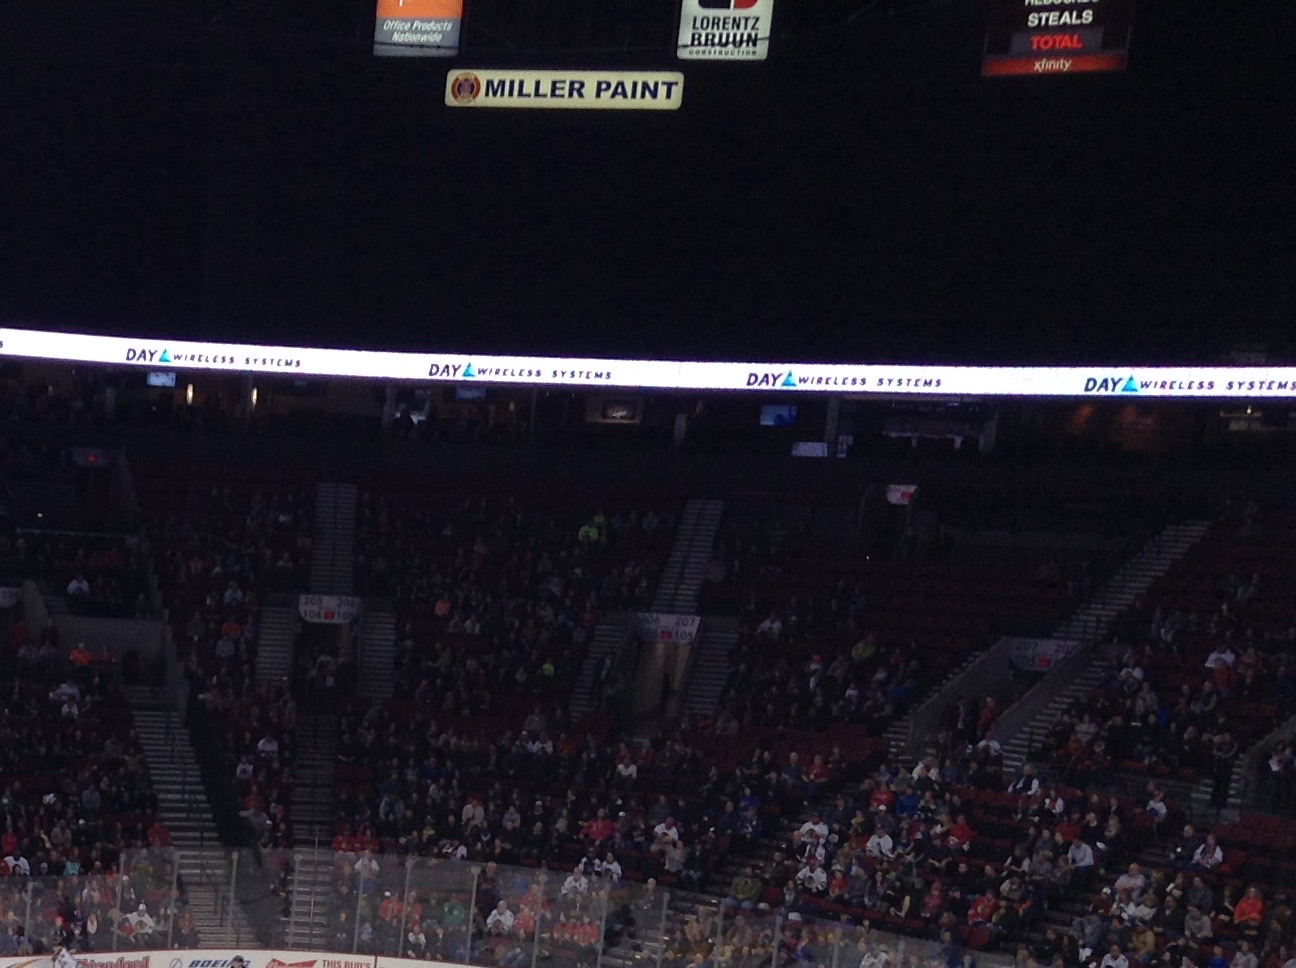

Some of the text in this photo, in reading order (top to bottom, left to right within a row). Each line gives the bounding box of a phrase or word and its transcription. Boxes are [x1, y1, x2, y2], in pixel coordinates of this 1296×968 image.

[383, 20, 452, 31] Office Products
[692, 15, 760, 31] LORENTZ
[1027, 9, 1094, 27] STEALS
[392, 31, 442, 42] Nationwide
[690, 31, 758, 47] BRUUN
[1030, 34, 1083, 50] TOTAL
[1033, 57, 1072, 73] xfinity
[484, 79, 679, 100] MILLER PAINT
[125, 347, 300, 368] DAY WIRELESS SYSTEMS
[428, 364, 612, 380] DAY WIRELESS SYSTEMS
[746, 372, 942, 388] DAY WIRELESS SYSTEMS
[1084, 377, 1296, 393] DAY WIRELESS SYSTEMS
[323, 960, 342, 968] THIS
